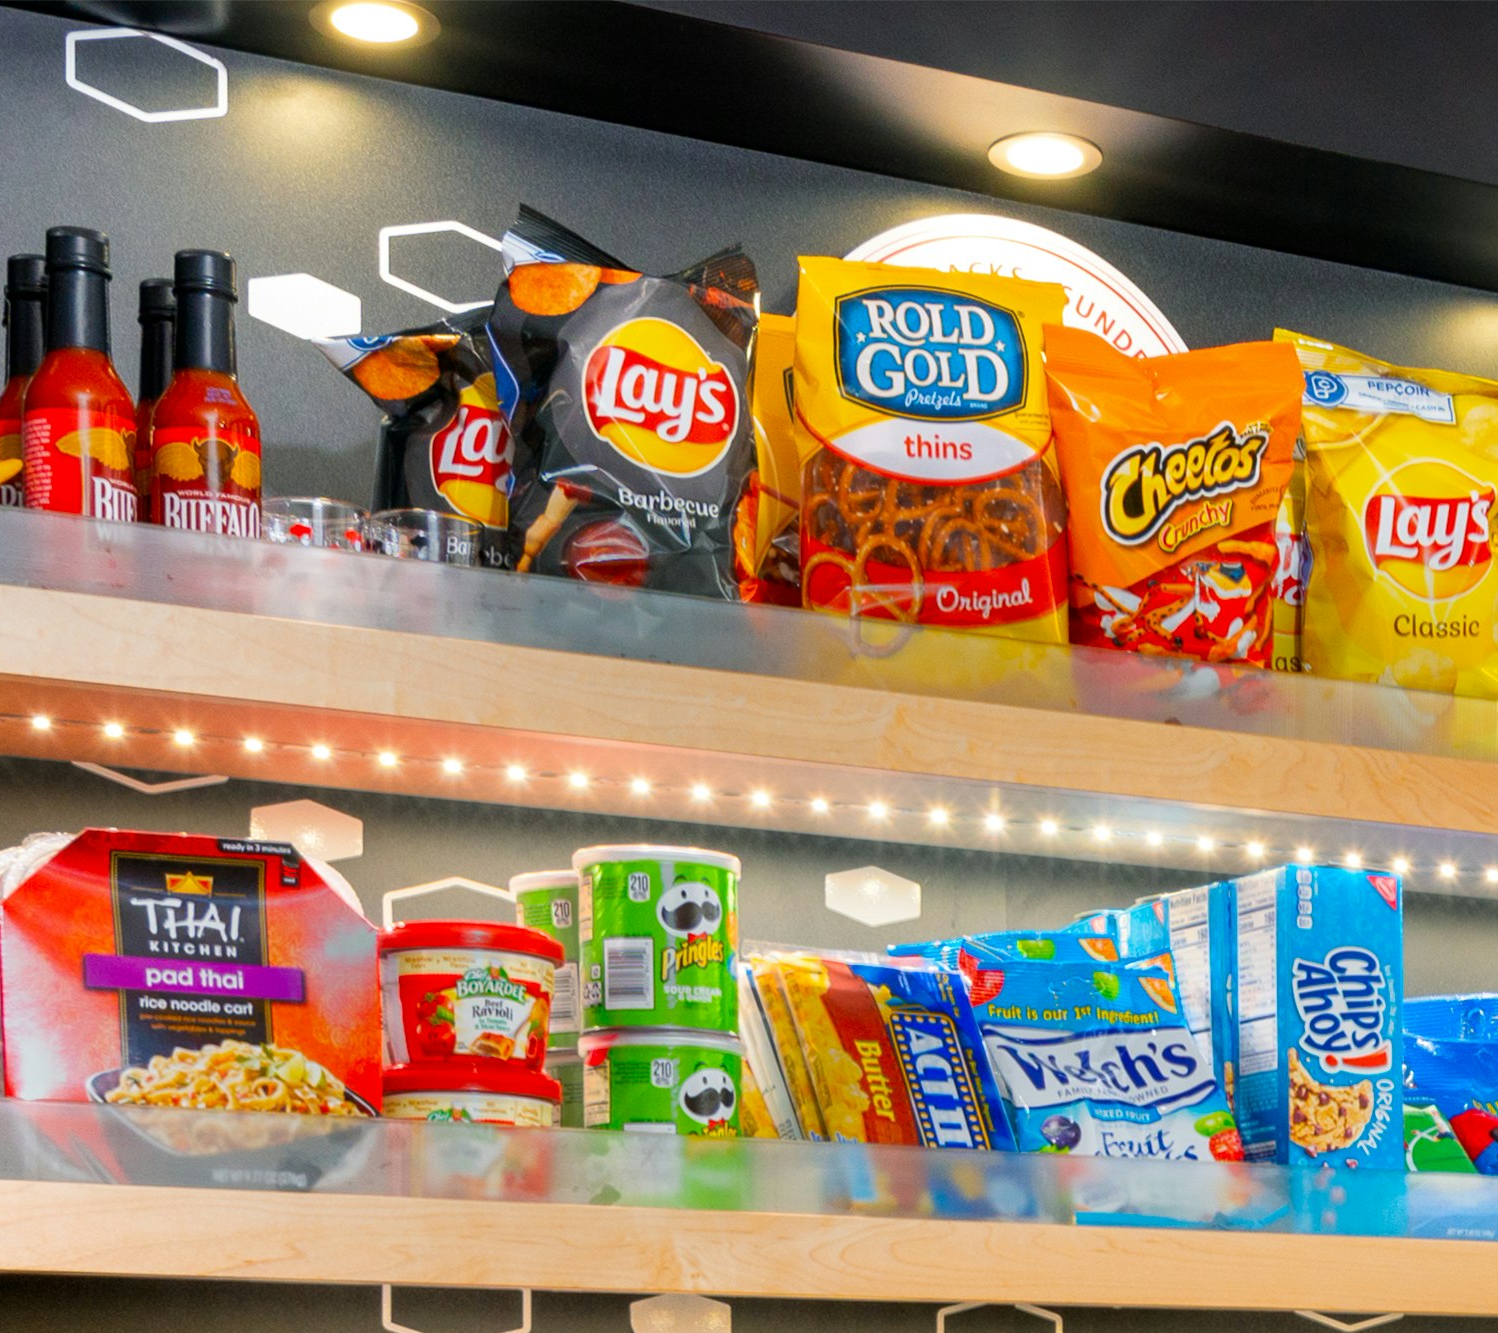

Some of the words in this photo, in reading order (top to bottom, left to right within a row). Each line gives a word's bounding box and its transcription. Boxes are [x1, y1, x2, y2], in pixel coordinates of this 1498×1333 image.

[863, 299, 994, 347] ROLD
[856, 342, 1009, 401] GOLD
[594, 346, 729, 443] Lay's
[904, 388, 962, 410] Pretzels
[903, 434, 973, 462] thins
[1105, 425, 1267, 539] Cheetos
[617, 487, 720, 518] Barbecue
[1158, 499, 1234, 551] Crunchy
[1374, 489, 1491, 571] Lay's
[936, 576, 1034, 614] Original
[1393, 614, 1481, 639] Classic
[222, 842, 245, 852] ready
[260, 844, 292, 855] minutes
[629, 874, 649, 893] 210
[129, 897, 242, 943] THAI
[553, 902, 570, 918] 210
[148, 940, 238, 958] KITCHEN
[661, 935, 725, 982] Pringles
[145, 966, 194, 988] pad
[200, 968, 245, 991] thai
[456, 980, 527, 1002] BOYARDEE
[663, 984, 692, 996] SOUR
[138, 995, 168, 1010] rice
[169, 997, 221, 1015] noodle
[223, 1003, 254, 1016] cart
[471, 1005, 514, 1022] Ravioli
[1328, 949, 1383, 1051] Chips
[987, 1004, 1022, 1021] Fruit
[1025, 1006, 1039, 1021] is
[1042, 1008, 1069, 1021] our
[1073, 1005, 1093, 1021] 1st
[1095, 1007, 1160, 1027] Ingredient!
[653, 1060, 673, 1079] 210
[904, 1026, 961, 1102] ACT
[997, 1040, 1198, 1093] Welch's
[853, 1039, 900, 1122] Butter
[1057, 1087, 1093, 1099] FAMILY
[1356, 1078, 1395, 1156] ORIGINAL
[1101, 1129, 1176, 1157] Fruit
